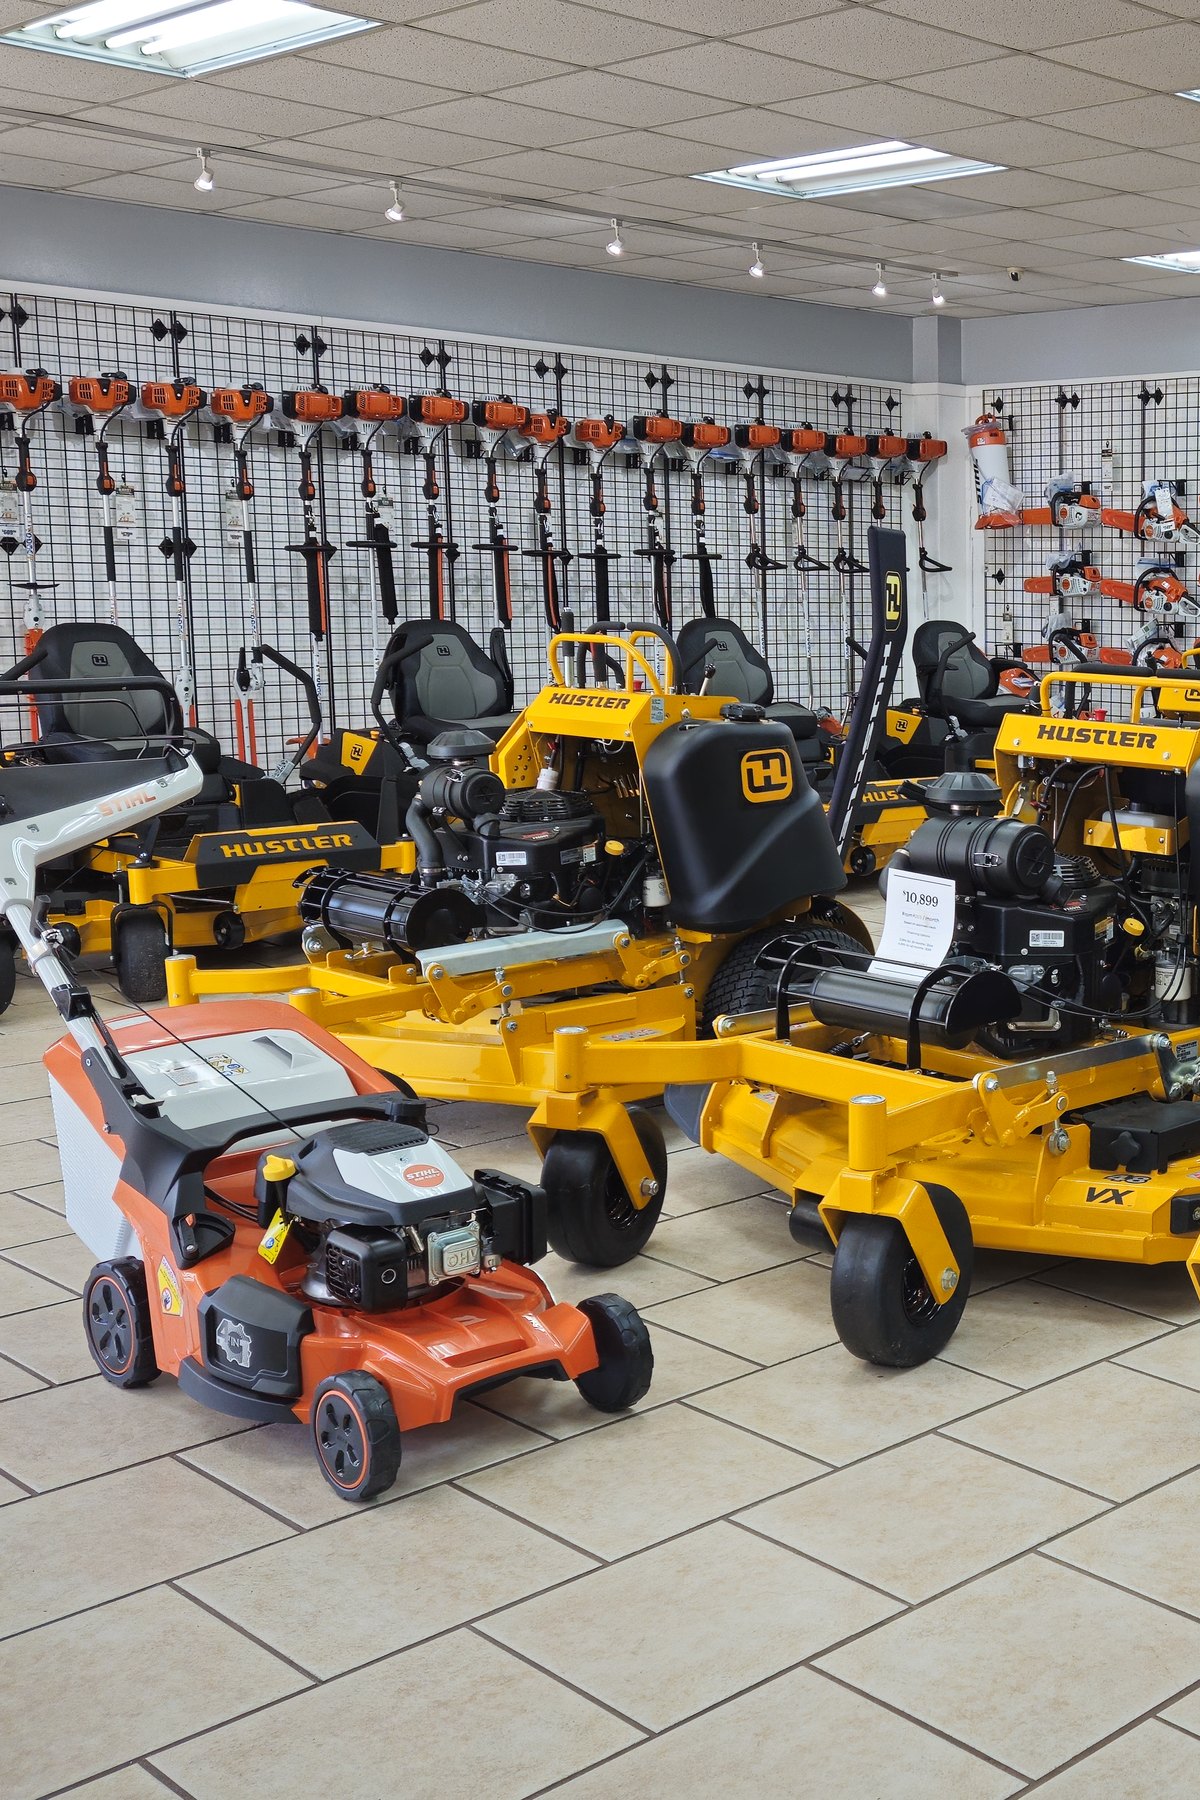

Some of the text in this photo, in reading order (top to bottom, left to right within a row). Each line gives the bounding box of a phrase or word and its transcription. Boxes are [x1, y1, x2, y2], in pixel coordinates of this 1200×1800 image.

[548, 693, 630, 710] HUSTLER
[1036, 724, 1158, 750] HUSTLER
[96, 791, 156, 817] STIHL
[220, 834, 352, 858] HUSTLER
[902, 890, 938, 908] $10,899
[406, 1168, 440, 1180] STIHL
[1086, 1186, 1134, 1206] VX
[447, 1248, 478, 1268] OHV
